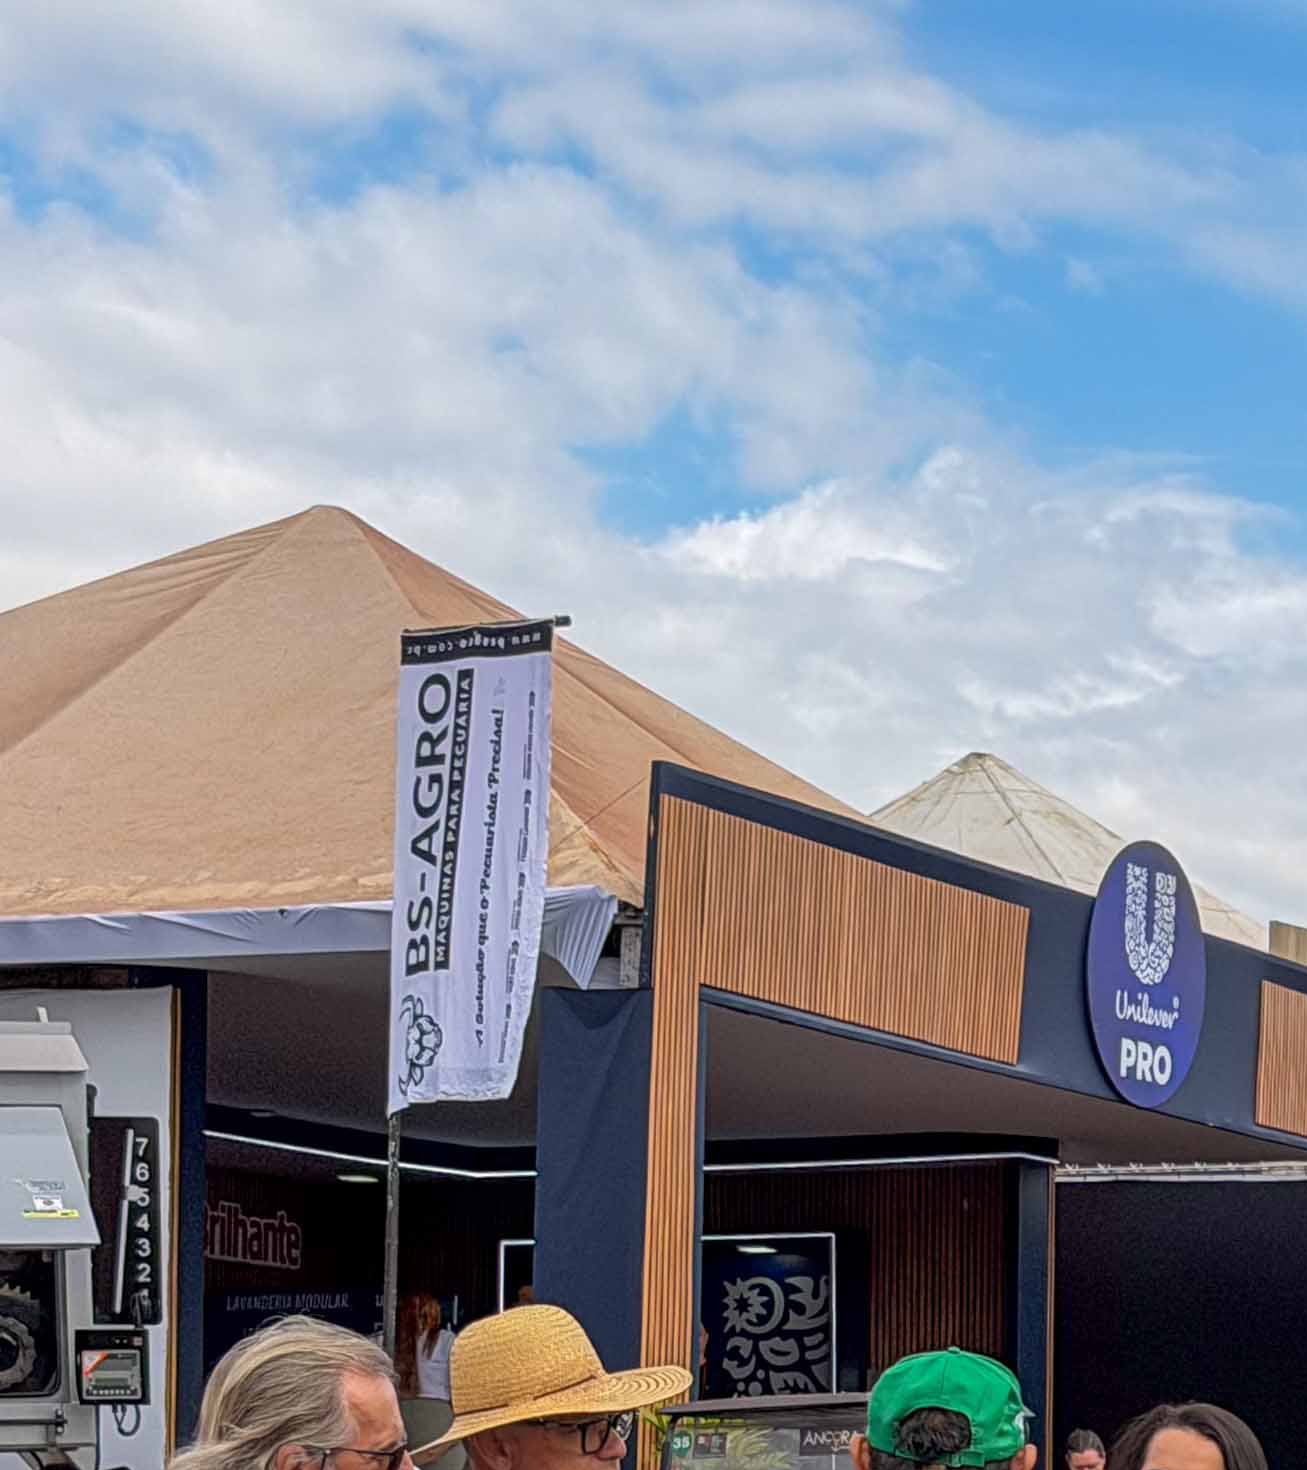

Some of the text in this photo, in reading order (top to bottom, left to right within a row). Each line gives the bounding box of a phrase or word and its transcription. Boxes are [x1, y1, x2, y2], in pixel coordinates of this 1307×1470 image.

[487, 709, 504, 790] Precisa!
[405, 672, 451, 977] BS-AGRO
[446, 791, 461, 842] PARA
[480, 791, 498, 895] Pecuarista
[480, 896, 489, 910] o
[478, 911, 489, 946] que
[1115, 989, 1180, 1029] Unilever
[1119, 1038, 1172, 1085] PRO
[135, 1138, 149, 1157] 7
[135, 1163, 149, 1182] 6
[136, 1214, 150, 1233] 4
[204, 1201, 301, 1269] rilhante
[136, 1238, 151, 1257] 3
[136, 1264, 151, 1282] 2
[296, 1293, 349, 1310] MODULAR
